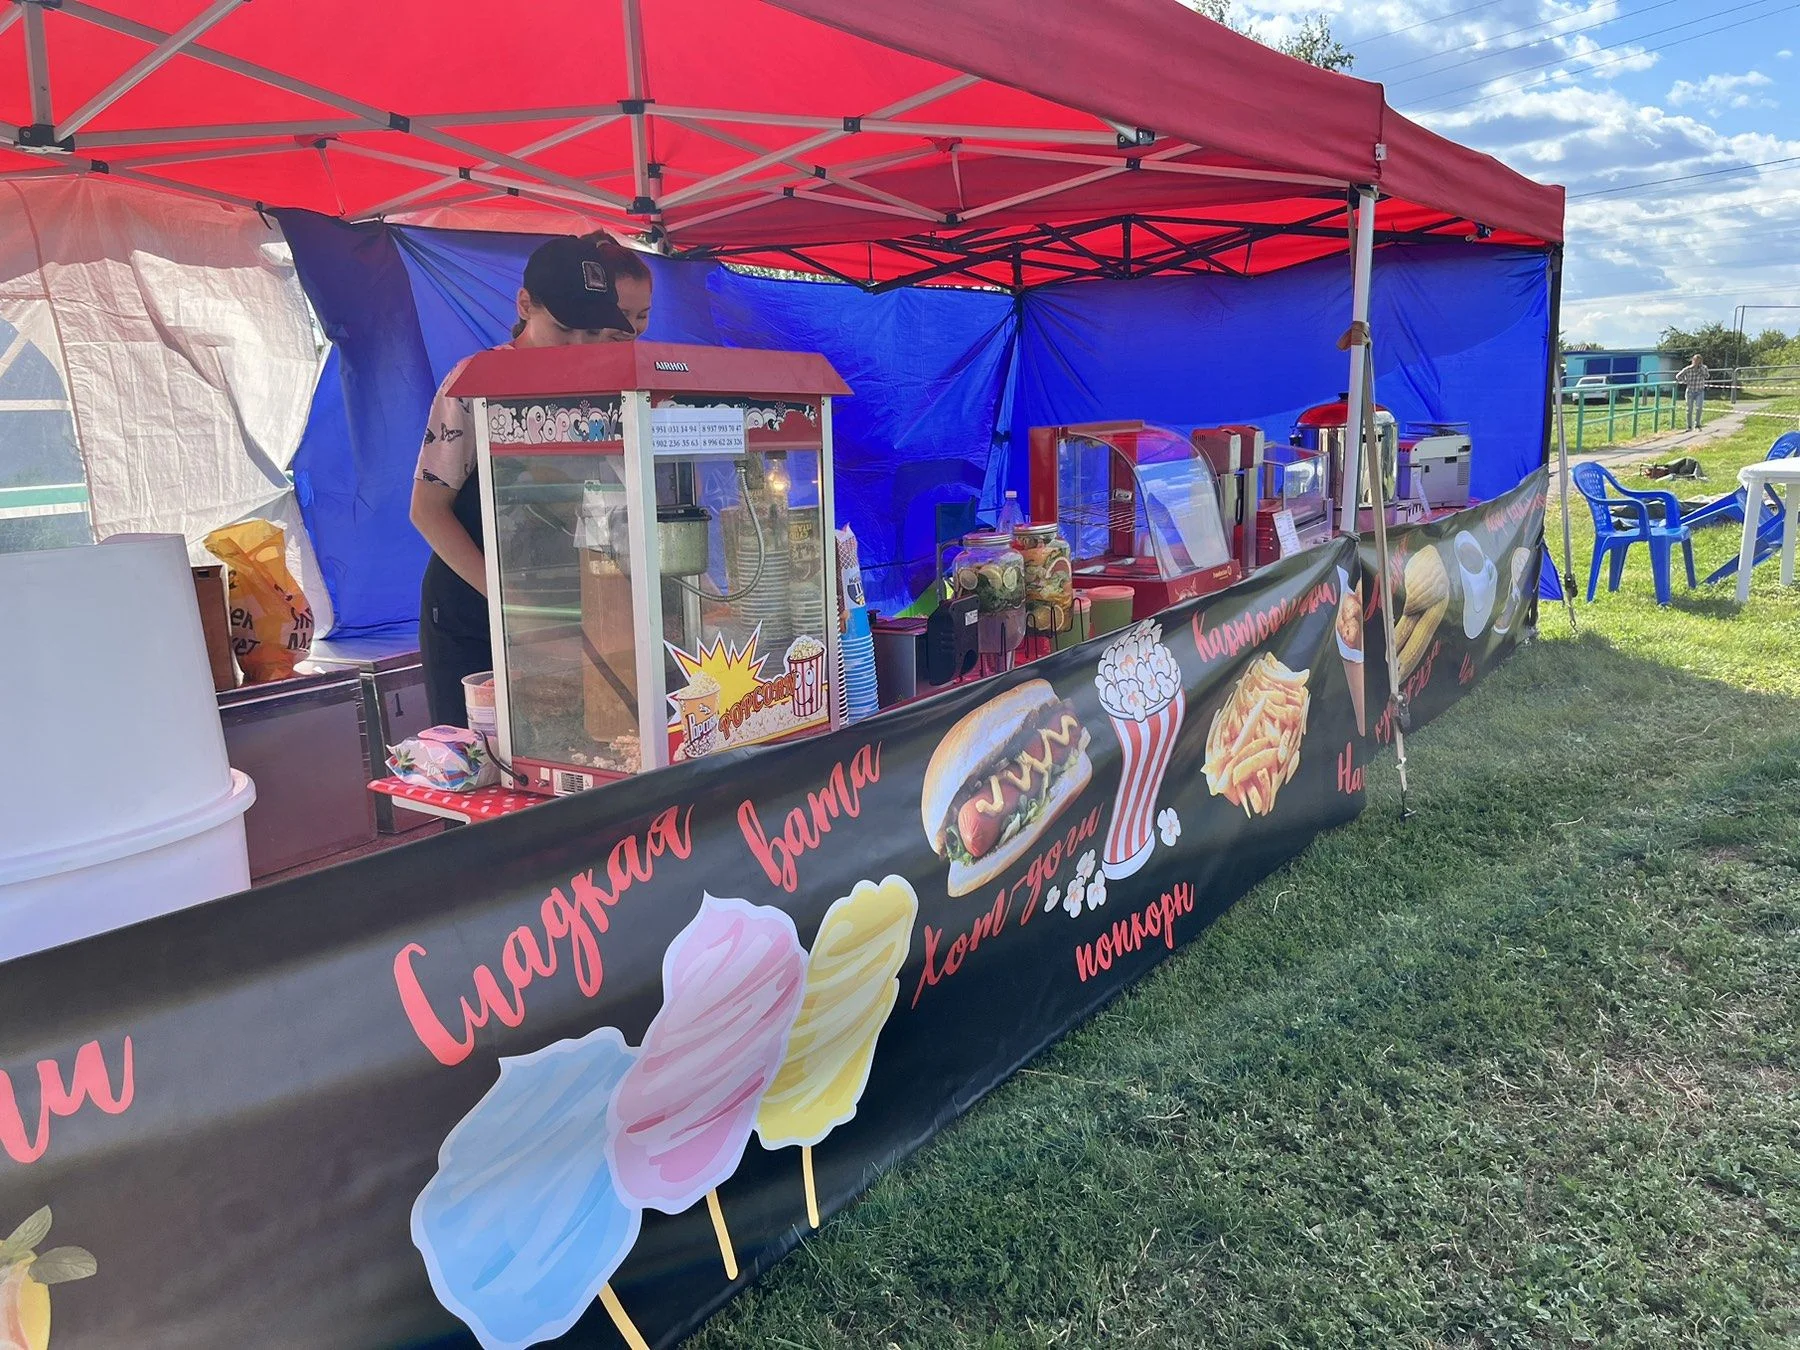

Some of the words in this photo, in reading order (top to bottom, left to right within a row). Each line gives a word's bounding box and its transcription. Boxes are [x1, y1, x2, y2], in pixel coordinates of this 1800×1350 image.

[655, 361, 689, 372] AIRHOT
[526, 404, 618, 444] POPCORN
[718, 670, 797, 741] POPCORN
[392, 803, 695, 1067] Сладкая
[911, 801, 1104, 1010] Хот-доги
[1075, 881, 1195, 982] попкорн
